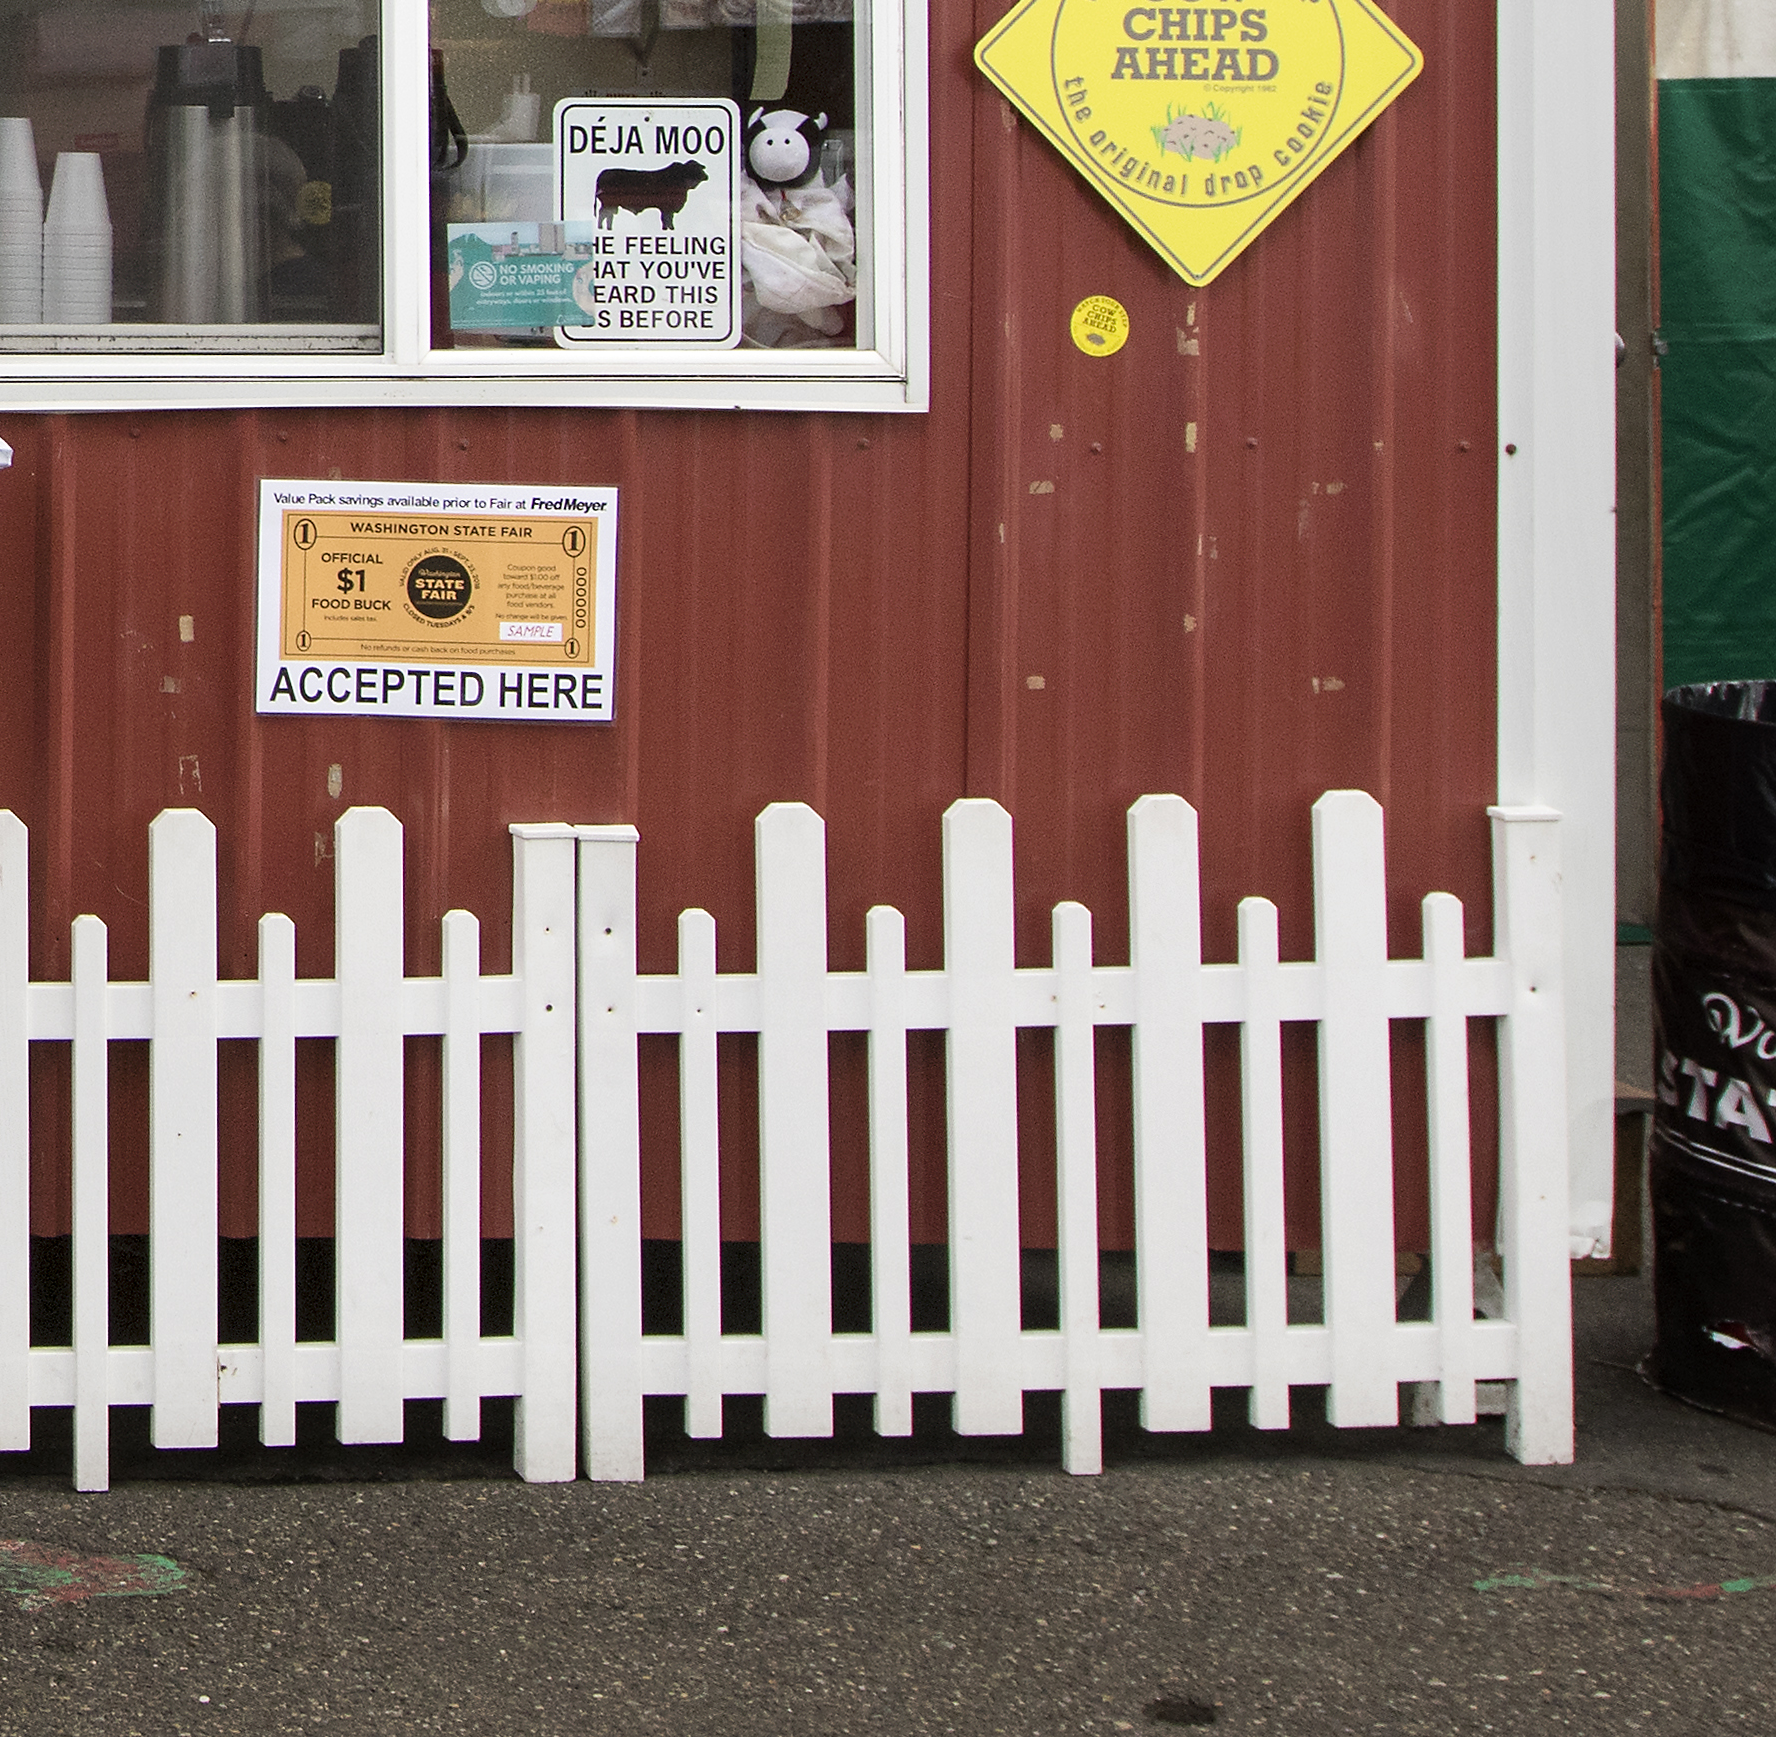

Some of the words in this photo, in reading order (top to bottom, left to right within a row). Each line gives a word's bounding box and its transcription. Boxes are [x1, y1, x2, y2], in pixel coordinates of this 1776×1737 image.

[1123, 8, 1268, 42] CHIPS
[1111, 47, 1280, 81] AHEAD
[570, 116, 644, 154] DÉJA
[656, 126, 725, 155] MOO
[1065, 75, 1092, 123] the
[1089, 130, 1187, 196] original
[1205, 164, 1264, 196] drop
[1274, 81, 1333, 168] cookie
[625, 236, 725, 255] FEELING
[500, 265, 517, 274] NO
[520, 263, 574, 273] SMOKING
[639, 261, 725, 279] YOU'VE
[500, 276, 517, 285] OR
[518, 274, 561, 284] VAPING
[595, 286, 655, 304] EARD
[665, 286, 718, 304] THIS
[1087, 311, 1116, 325] CHIPS
[1093, 304, 1116, 316] COW
[620, 310, 713, 328] BEFORE
[1083, 318, 1116, 332] AHEAD
[274, 493, 305, 504] Value
[309, 494, 336, 505] Pack
[339, 495, 383, 508] savings
[387, 496, 439, 508] available
[443, 498, 471, 510] prior
[474, 499, 486, 509] to
[490, 499, 511, 509] Fair
[515, 500, 526, 509] at
[351, 523, 448, 535] WASHINGTON
[453, 525, 497, 537] STATE
[501, 527, 532, 538] FAIR
[321, 552, 383, 564] OFFICIAL
[337, 567, 366, 594] $1
[312, 598, 350, 610] FOOD
[354, 599, 391, 611] BUCK
[508, 624, 554, 638] SAMPLE
[270, 667, 484, 707] ACCEPTED
[500, 672, 603, 709] HERE
